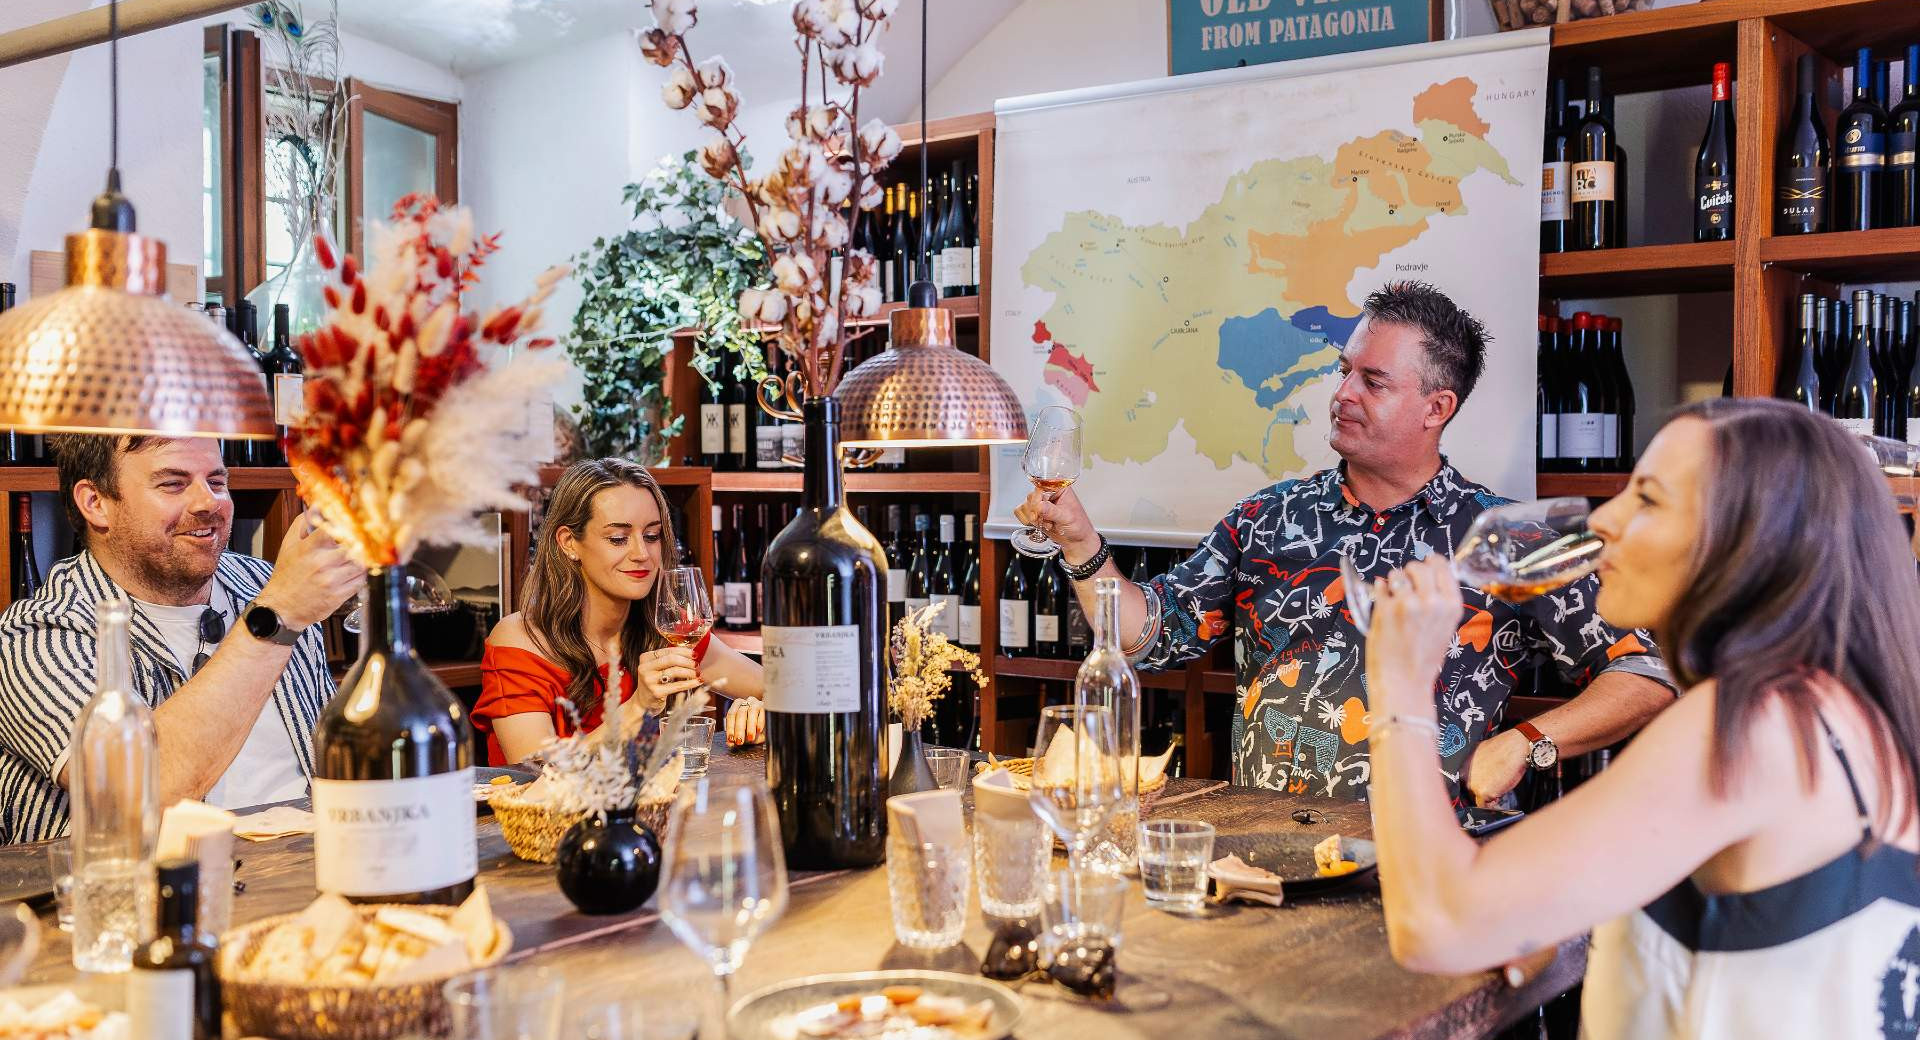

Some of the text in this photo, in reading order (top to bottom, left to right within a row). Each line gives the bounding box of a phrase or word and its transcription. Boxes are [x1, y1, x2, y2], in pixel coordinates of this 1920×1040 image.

[1201, 6, 1395, 51] FROM PATAGONIA
[1486, 88, 1538, 101] HUNGARY
[1783, 206, 1815, 215] SULAR
[1395, 263, 1429, 273] Podravje
